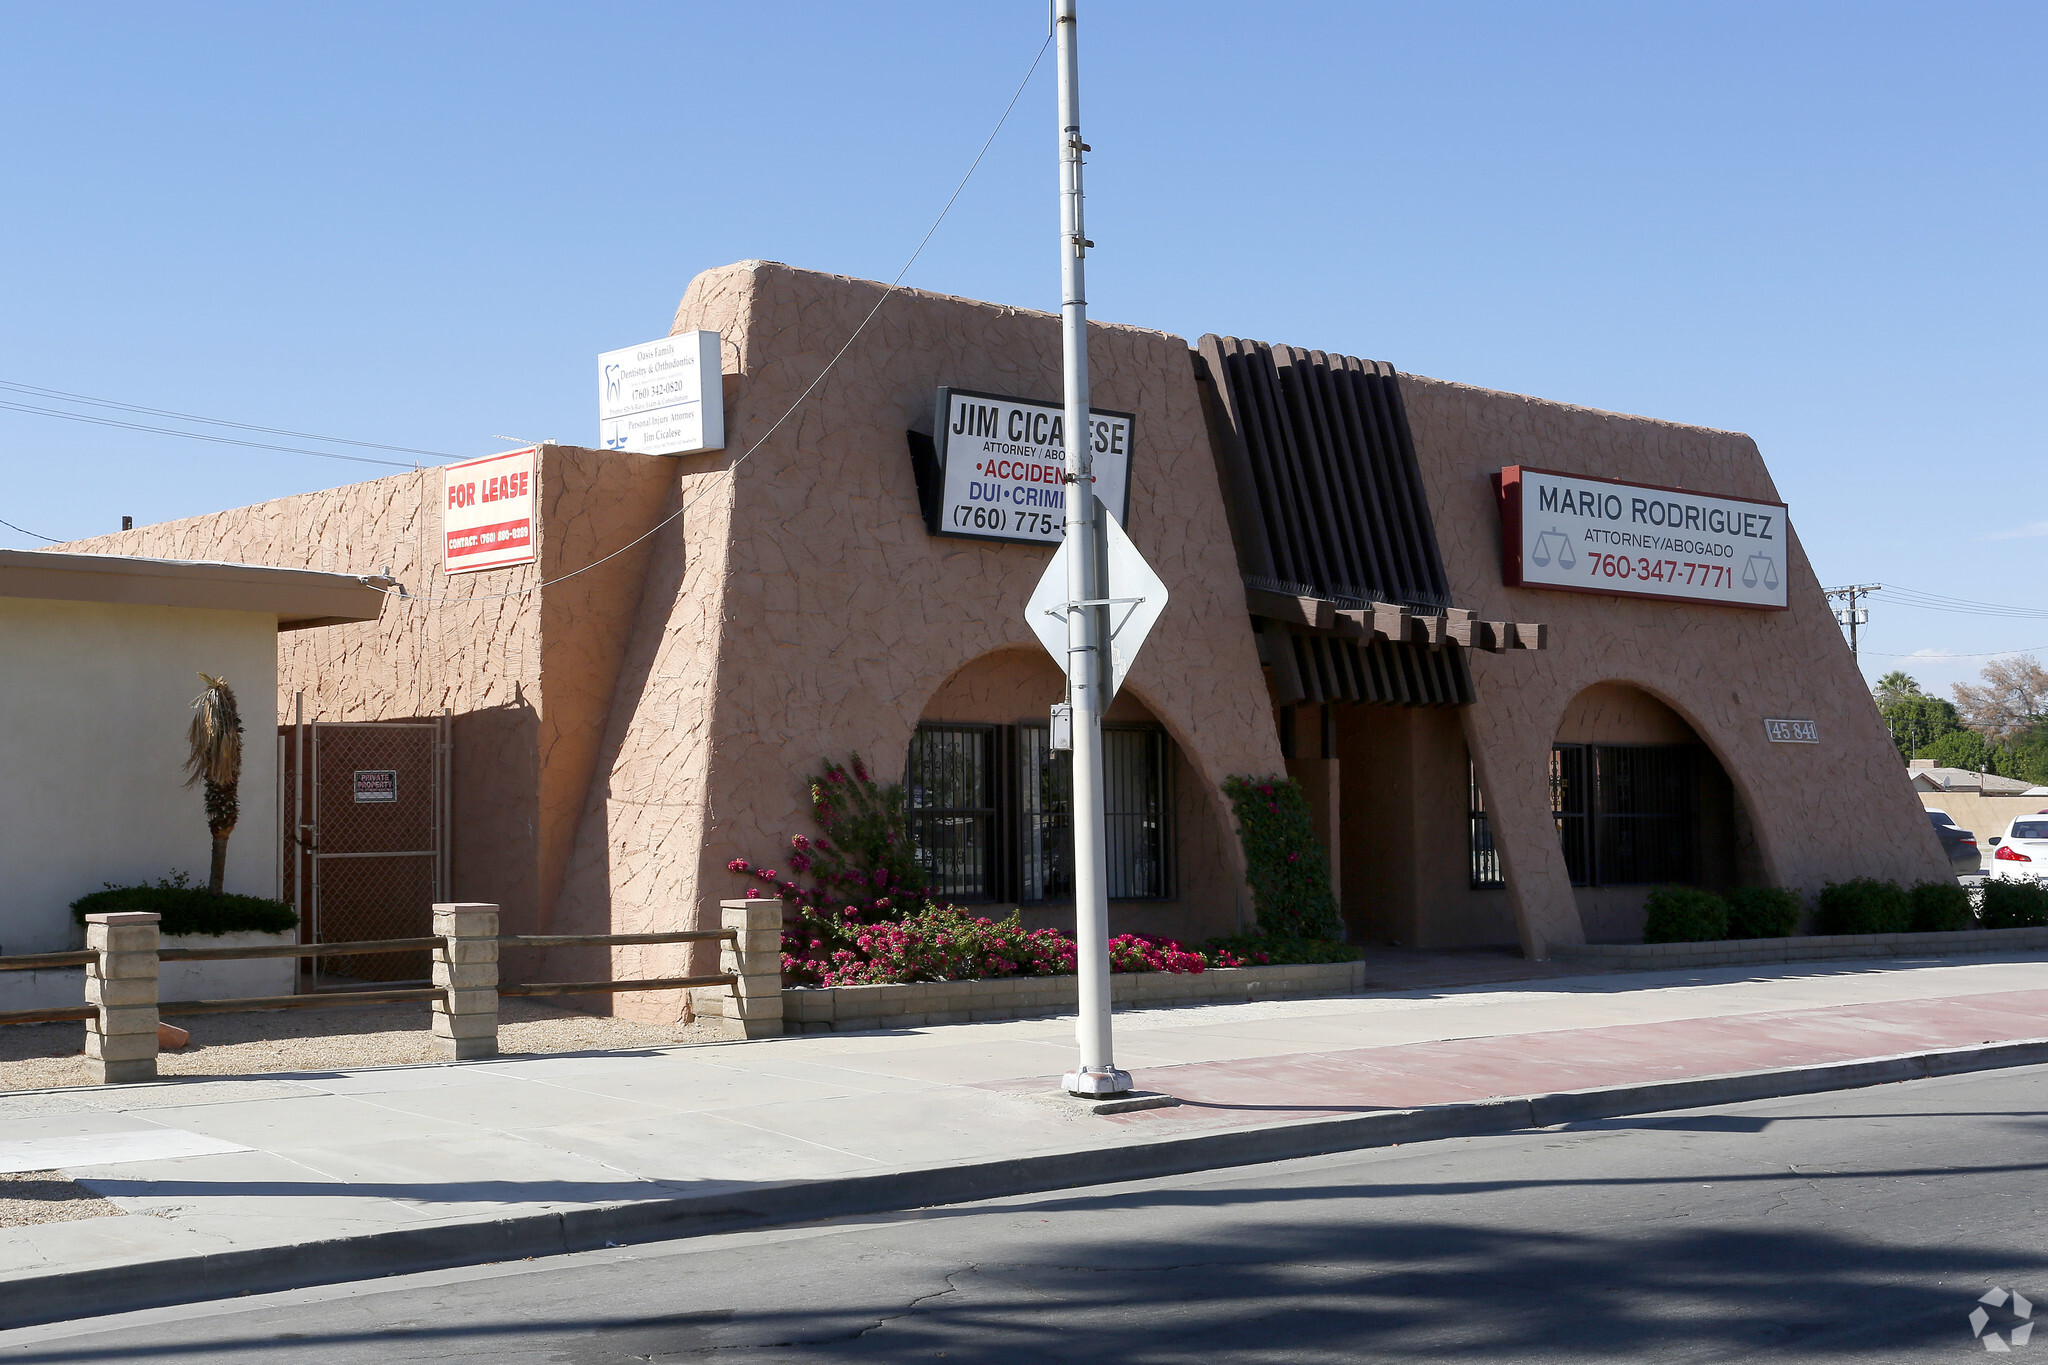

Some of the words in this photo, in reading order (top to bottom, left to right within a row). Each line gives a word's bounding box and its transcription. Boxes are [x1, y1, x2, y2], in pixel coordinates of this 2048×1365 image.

[637, 351, 653, 361] Oasis
[655, 345, 674, 357] Family
[621, 367, 646, 380] Dentistry
[648, 363, 654, 374] &
[655, 356, 694, 372] Orthodontics
[632, 388, 650, 401] (760)
[651, 380, 683, 397] 342-0820
[628, 416, 651, 430] Personal
[652, 415, 669, 427] Injury
[671, 410, 695, 422] Attorney
[952, 402, 1000, 439] JIM
[1008, 409, 1125, 455] CICASE
[643, 432, 655, 443] Jim
[655, 428, 681, 441] Cicalese
[982, 441, 1037, 457] ATTORNEY
[448, 482, 475, 510] FOR
[482, 471, 528, 503] LEASE
[953, 504, 1007, 531] (760)
[1539, 485, 1623, 520] MARIO
[1631, 497, 1773, 540] RODRIGUEZ
[1584, 528, 1734, 558] ATTORNEY/ABOGADO
[1588, 552, 1733, 589] 760-347-7771
